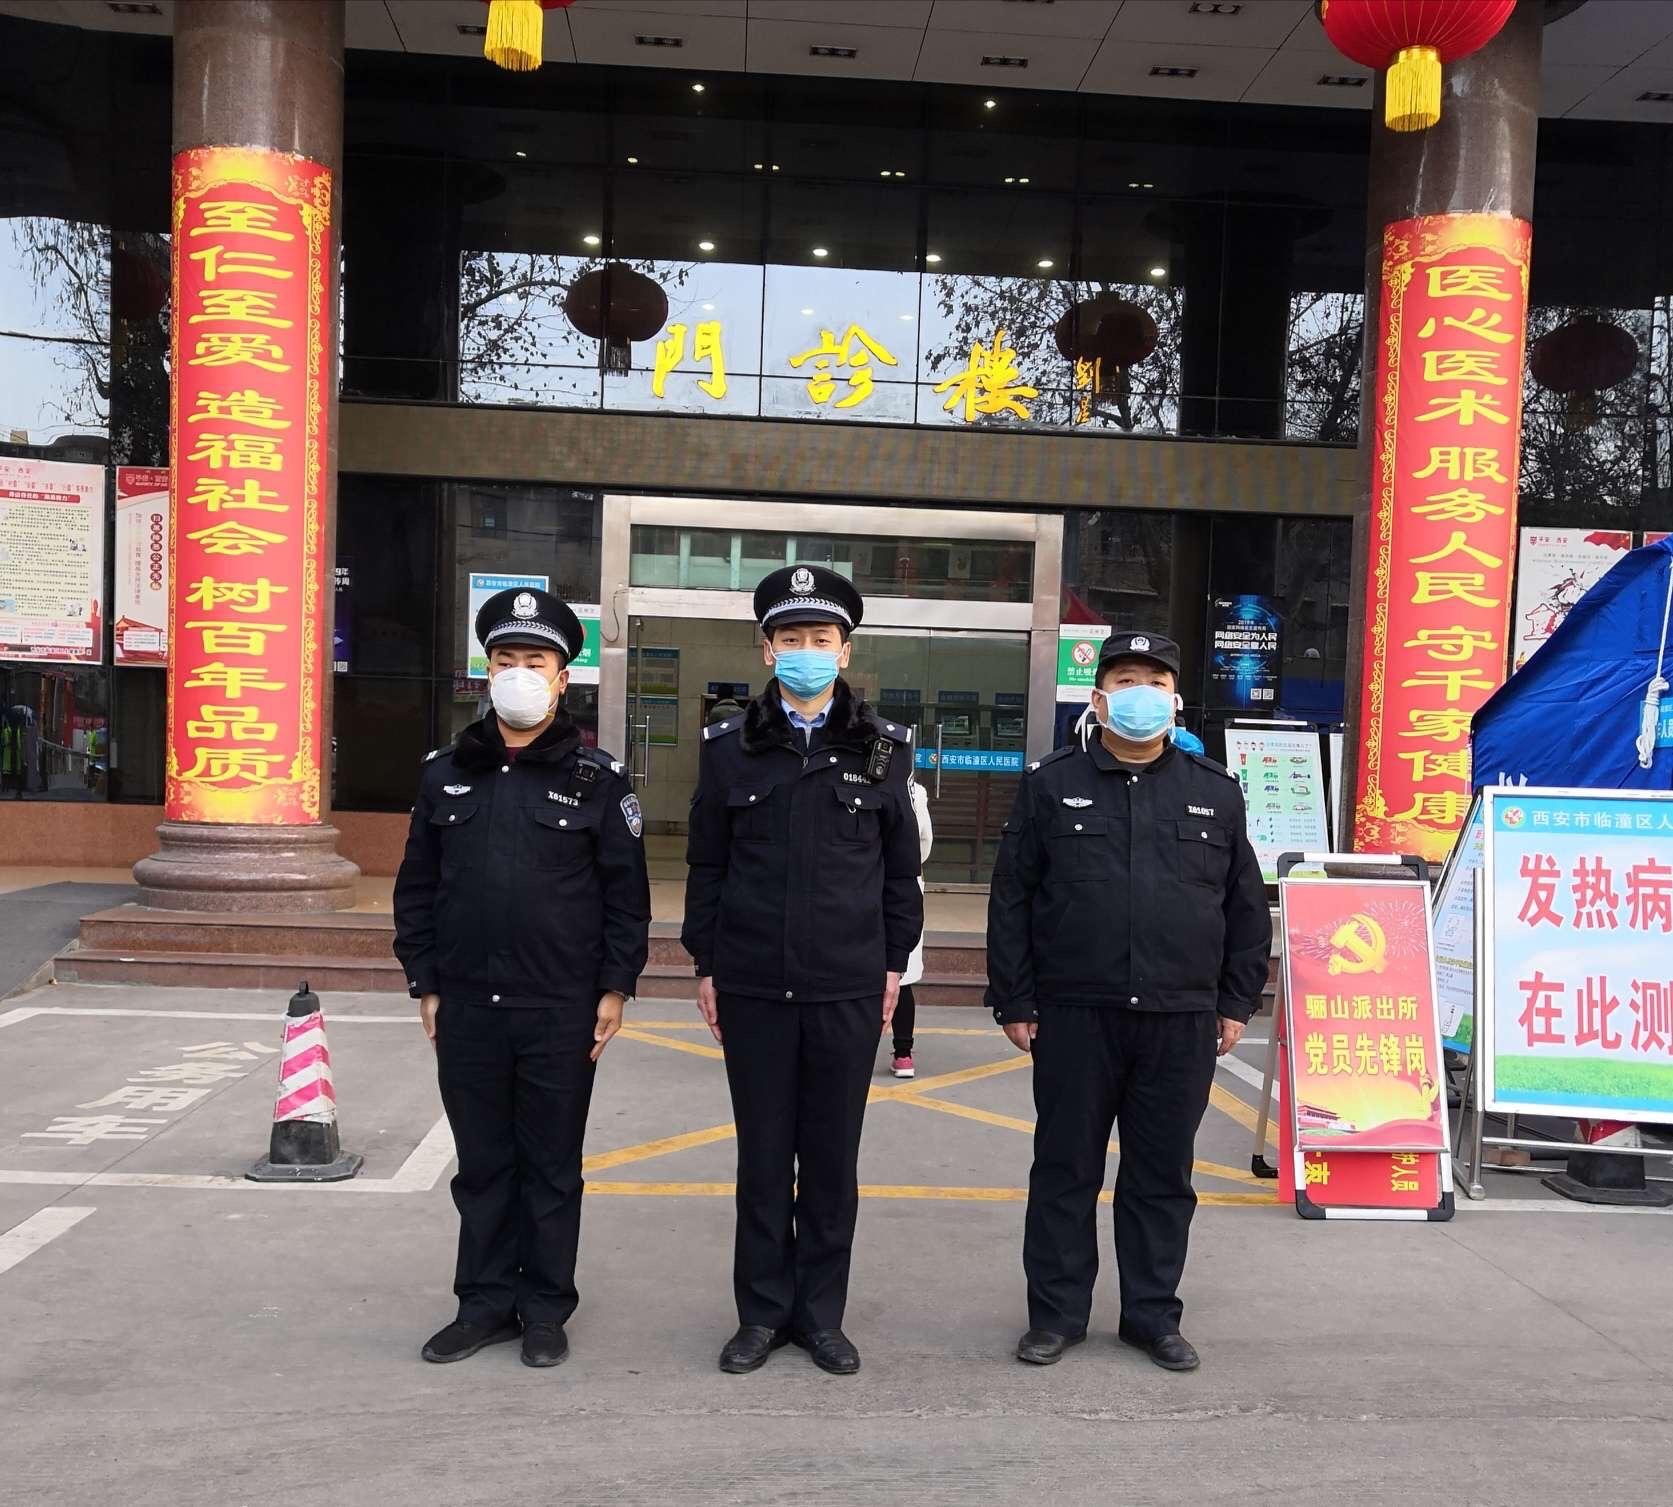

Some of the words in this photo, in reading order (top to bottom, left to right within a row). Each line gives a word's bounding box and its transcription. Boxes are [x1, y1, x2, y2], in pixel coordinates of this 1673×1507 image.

[1517, 853, 1673, 933] 发热病
[1304, 994, 1420, 1022] 骊山派出所
[1517, 970, 1673, 1057] 在此测
[1304, 1030, 1429, 1078] 党员先锋岗
